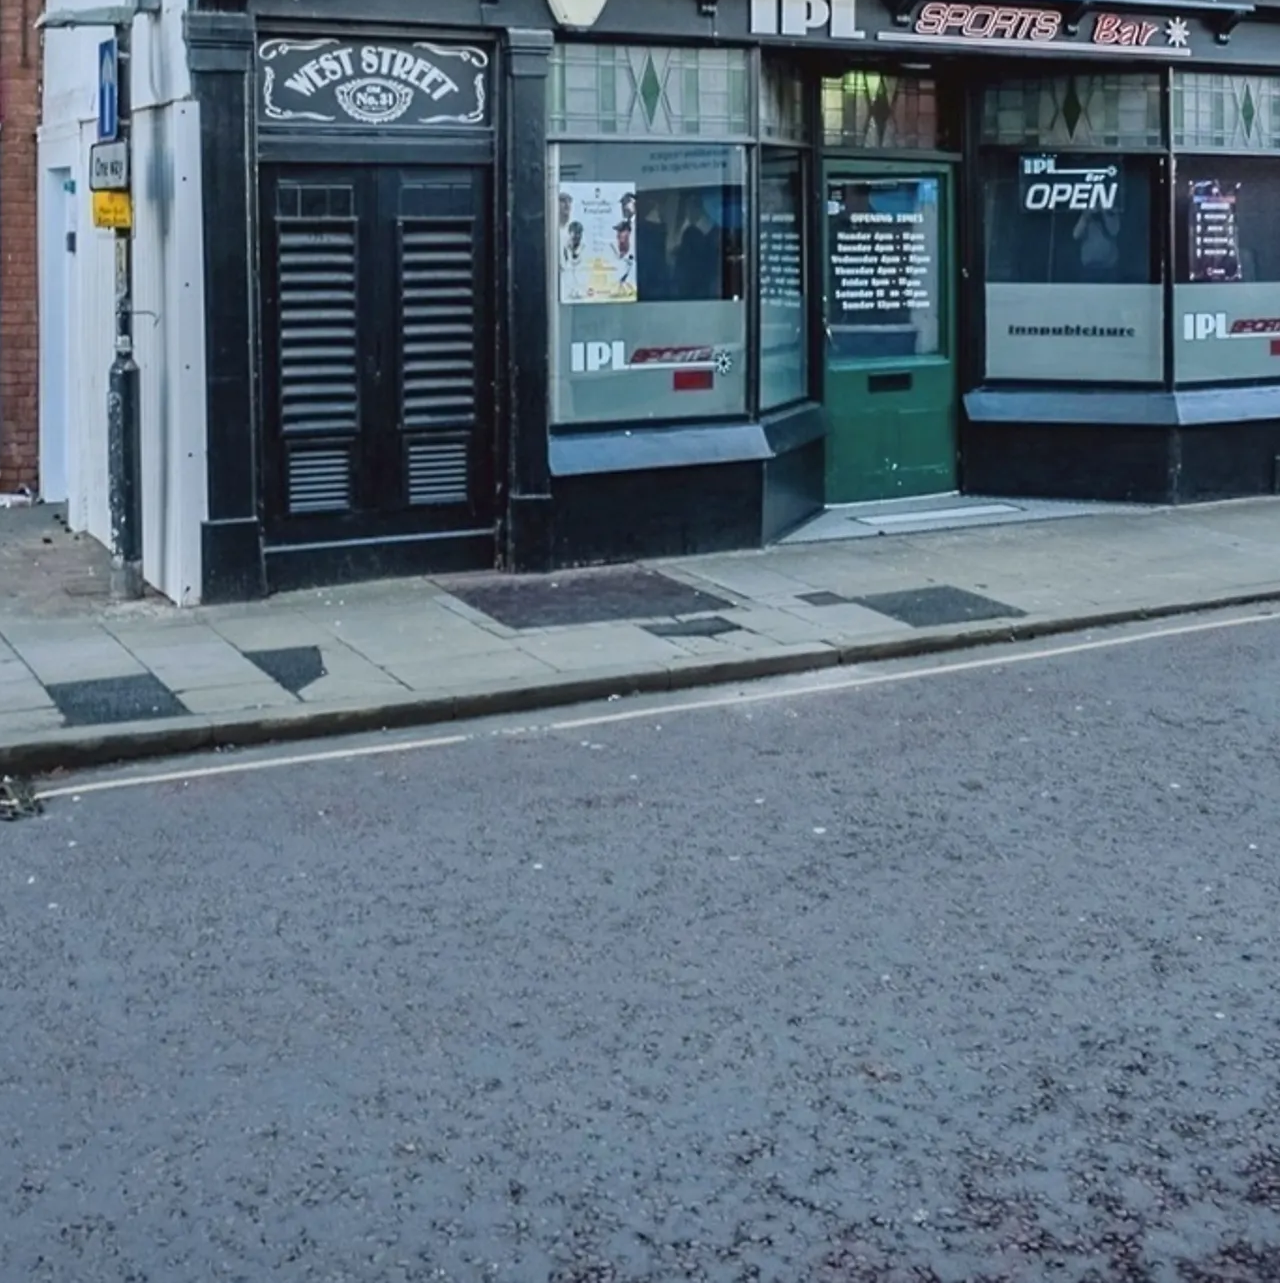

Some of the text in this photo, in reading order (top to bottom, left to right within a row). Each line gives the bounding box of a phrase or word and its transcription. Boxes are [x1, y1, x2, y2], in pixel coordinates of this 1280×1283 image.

[915, 2, 1062, 42] SPORTS
[1093, 14, 1160, 46] Bar
[284, 46, 459, 101] WEST STREET
[94, 157, 109, 177] One
[1024, 159, 1056, 174] IPL
[1026, 183, 1118, 209] OPEN
[1184, 313, 1229, 340] IPL
[571, 341, 626, 371] IPL
